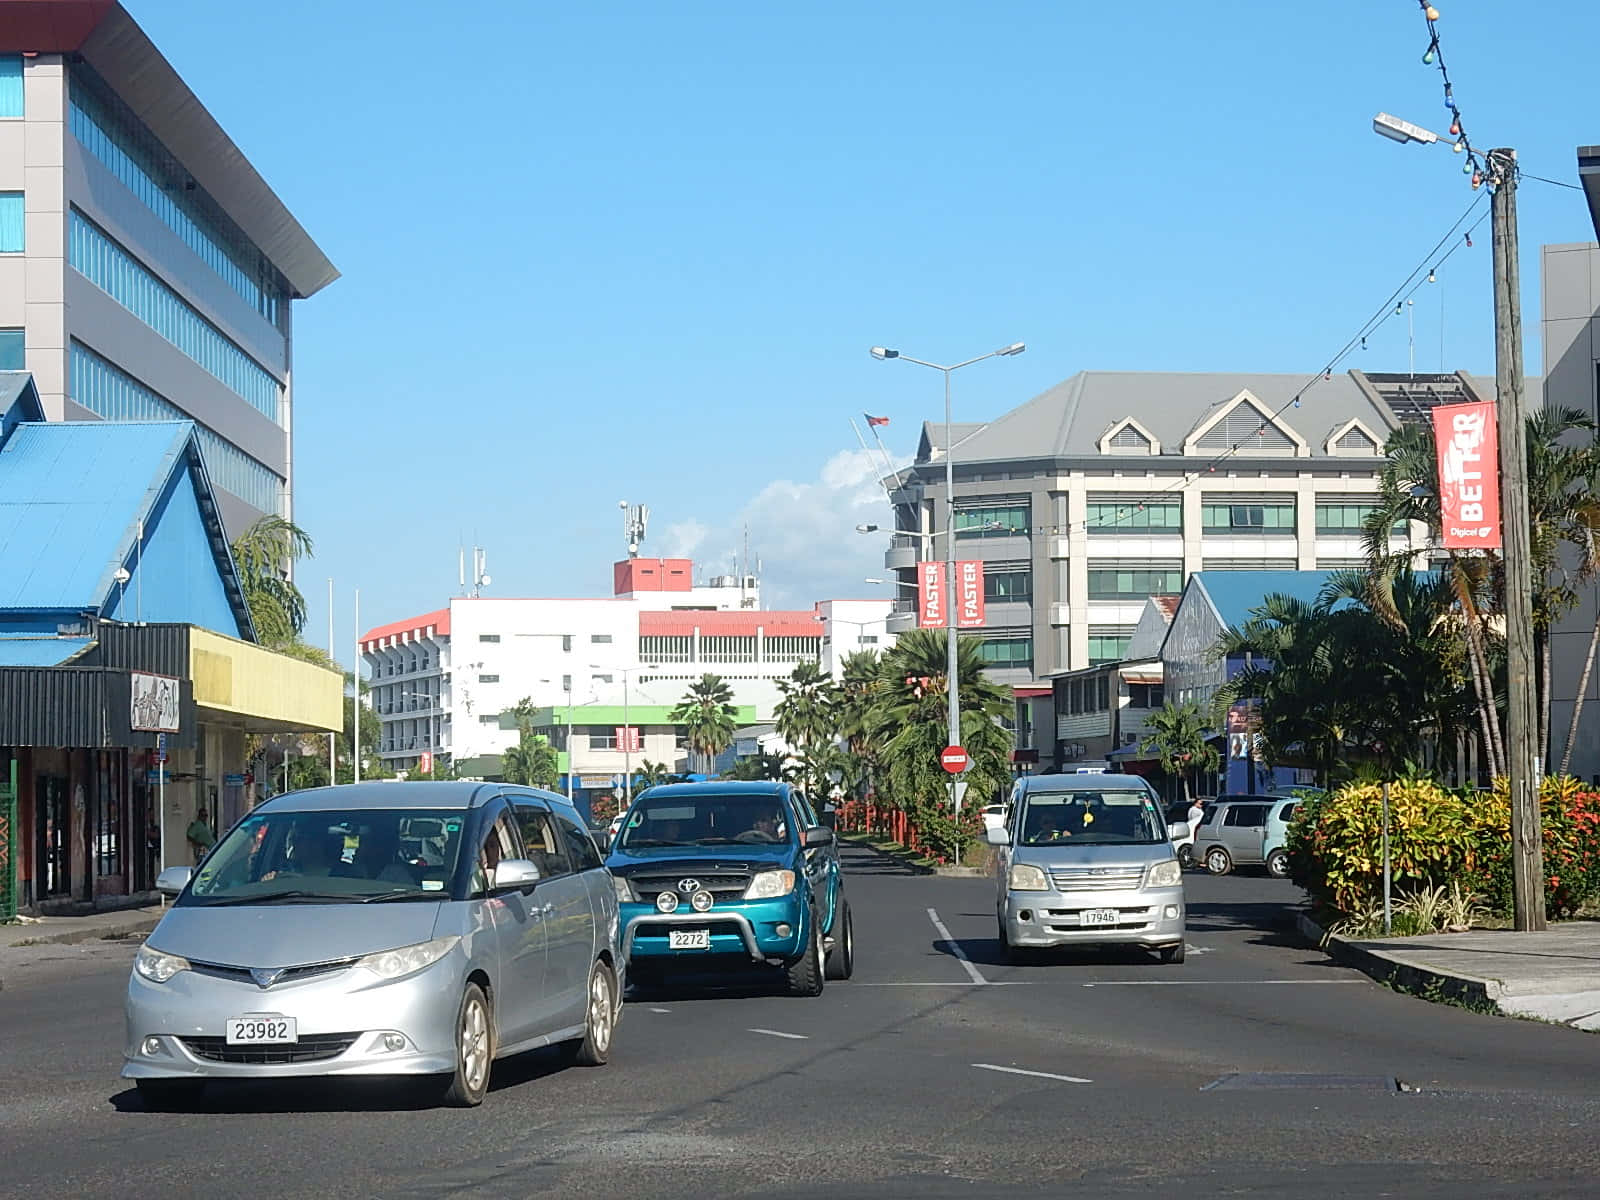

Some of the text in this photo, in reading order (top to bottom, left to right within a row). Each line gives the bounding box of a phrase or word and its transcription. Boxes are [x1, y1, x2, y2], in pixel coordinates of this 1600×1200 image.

[1452, 413, 1483, 521] BETTER
[1450, 527, 1478, 537] Digicel
[925, 564, 939, 618] FASTER
[963, 563, 978, 617] FASTER
[675, 934, 703, 945] 2272
[236, 1022, 287, 1039] 23982
